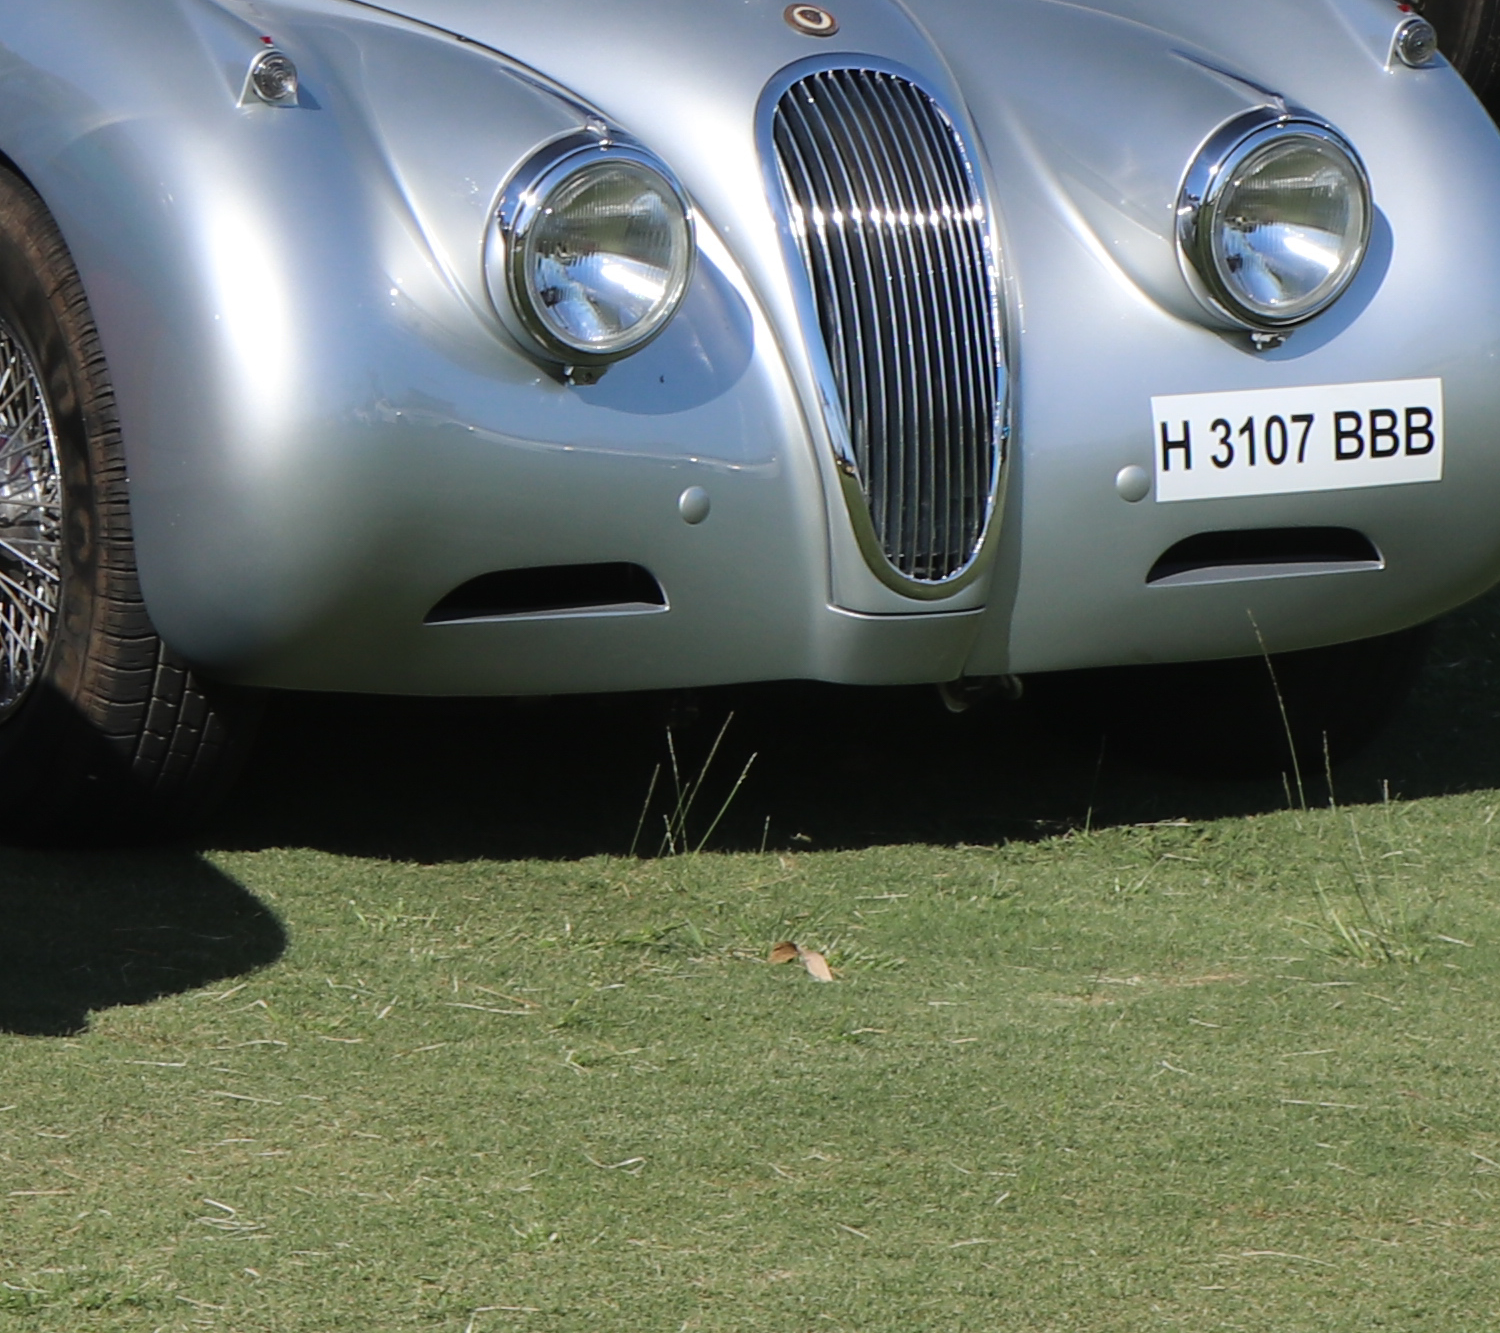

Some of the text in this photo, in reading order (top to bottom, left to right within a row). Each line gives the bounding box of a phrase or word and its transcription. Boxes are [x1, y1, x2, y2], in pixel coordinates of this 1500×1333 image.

[1160, 406, 1435, 471] H 3107 BBB
